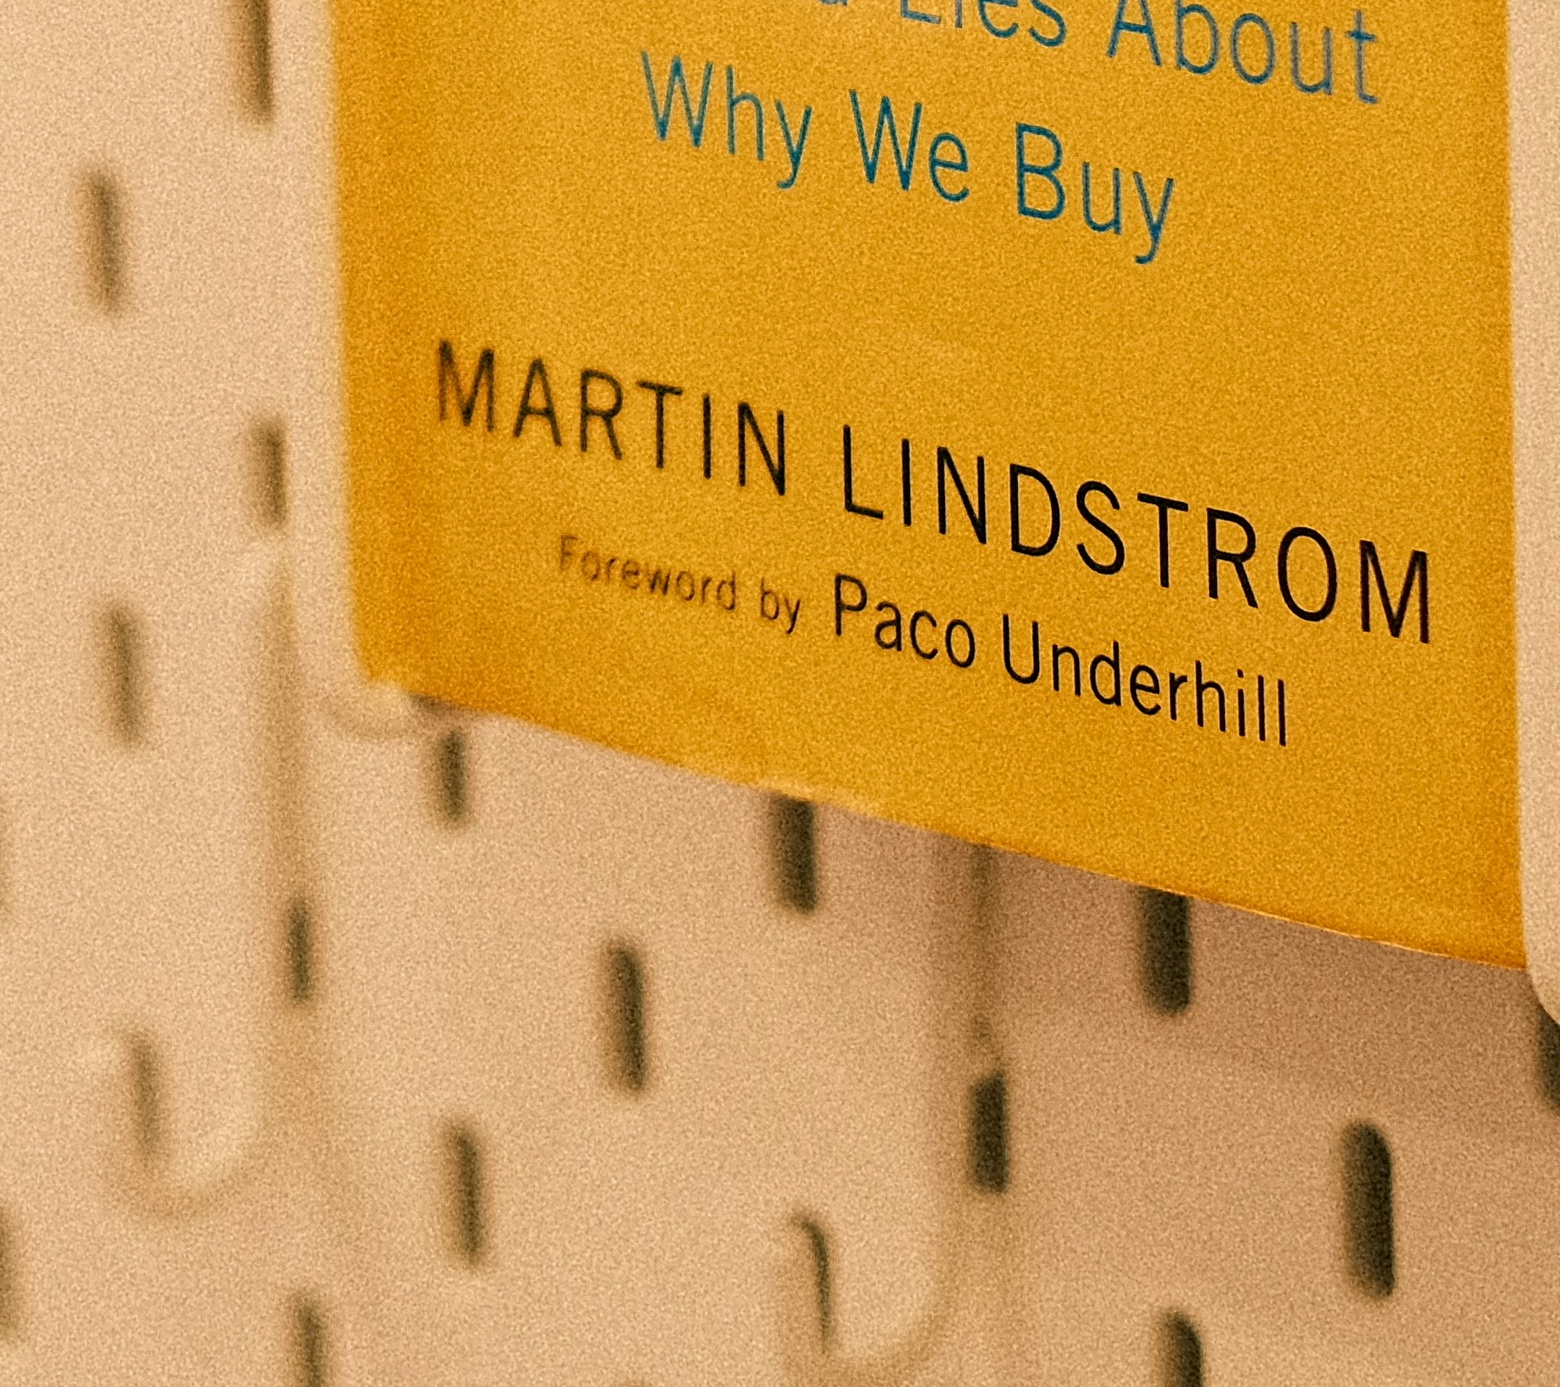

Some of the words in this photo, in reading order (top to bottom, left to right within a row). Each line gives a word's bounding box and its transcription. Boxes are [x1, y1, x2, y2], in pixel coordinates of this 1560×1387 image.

[639, 51, 816, 193] Why
[847, 88, 972, 206] We
[1012, 119, 1177, 268] Buy
[434, 337, 790, 499] MARTIN
[839, 423, 1433, 646] LINDSTROM
[556, 533, 739, 614] Foreword
[758, 574, 804, 635] by
[831, 570, 980, 672] Paco
[999, 613, 1290, 748] Underhill
